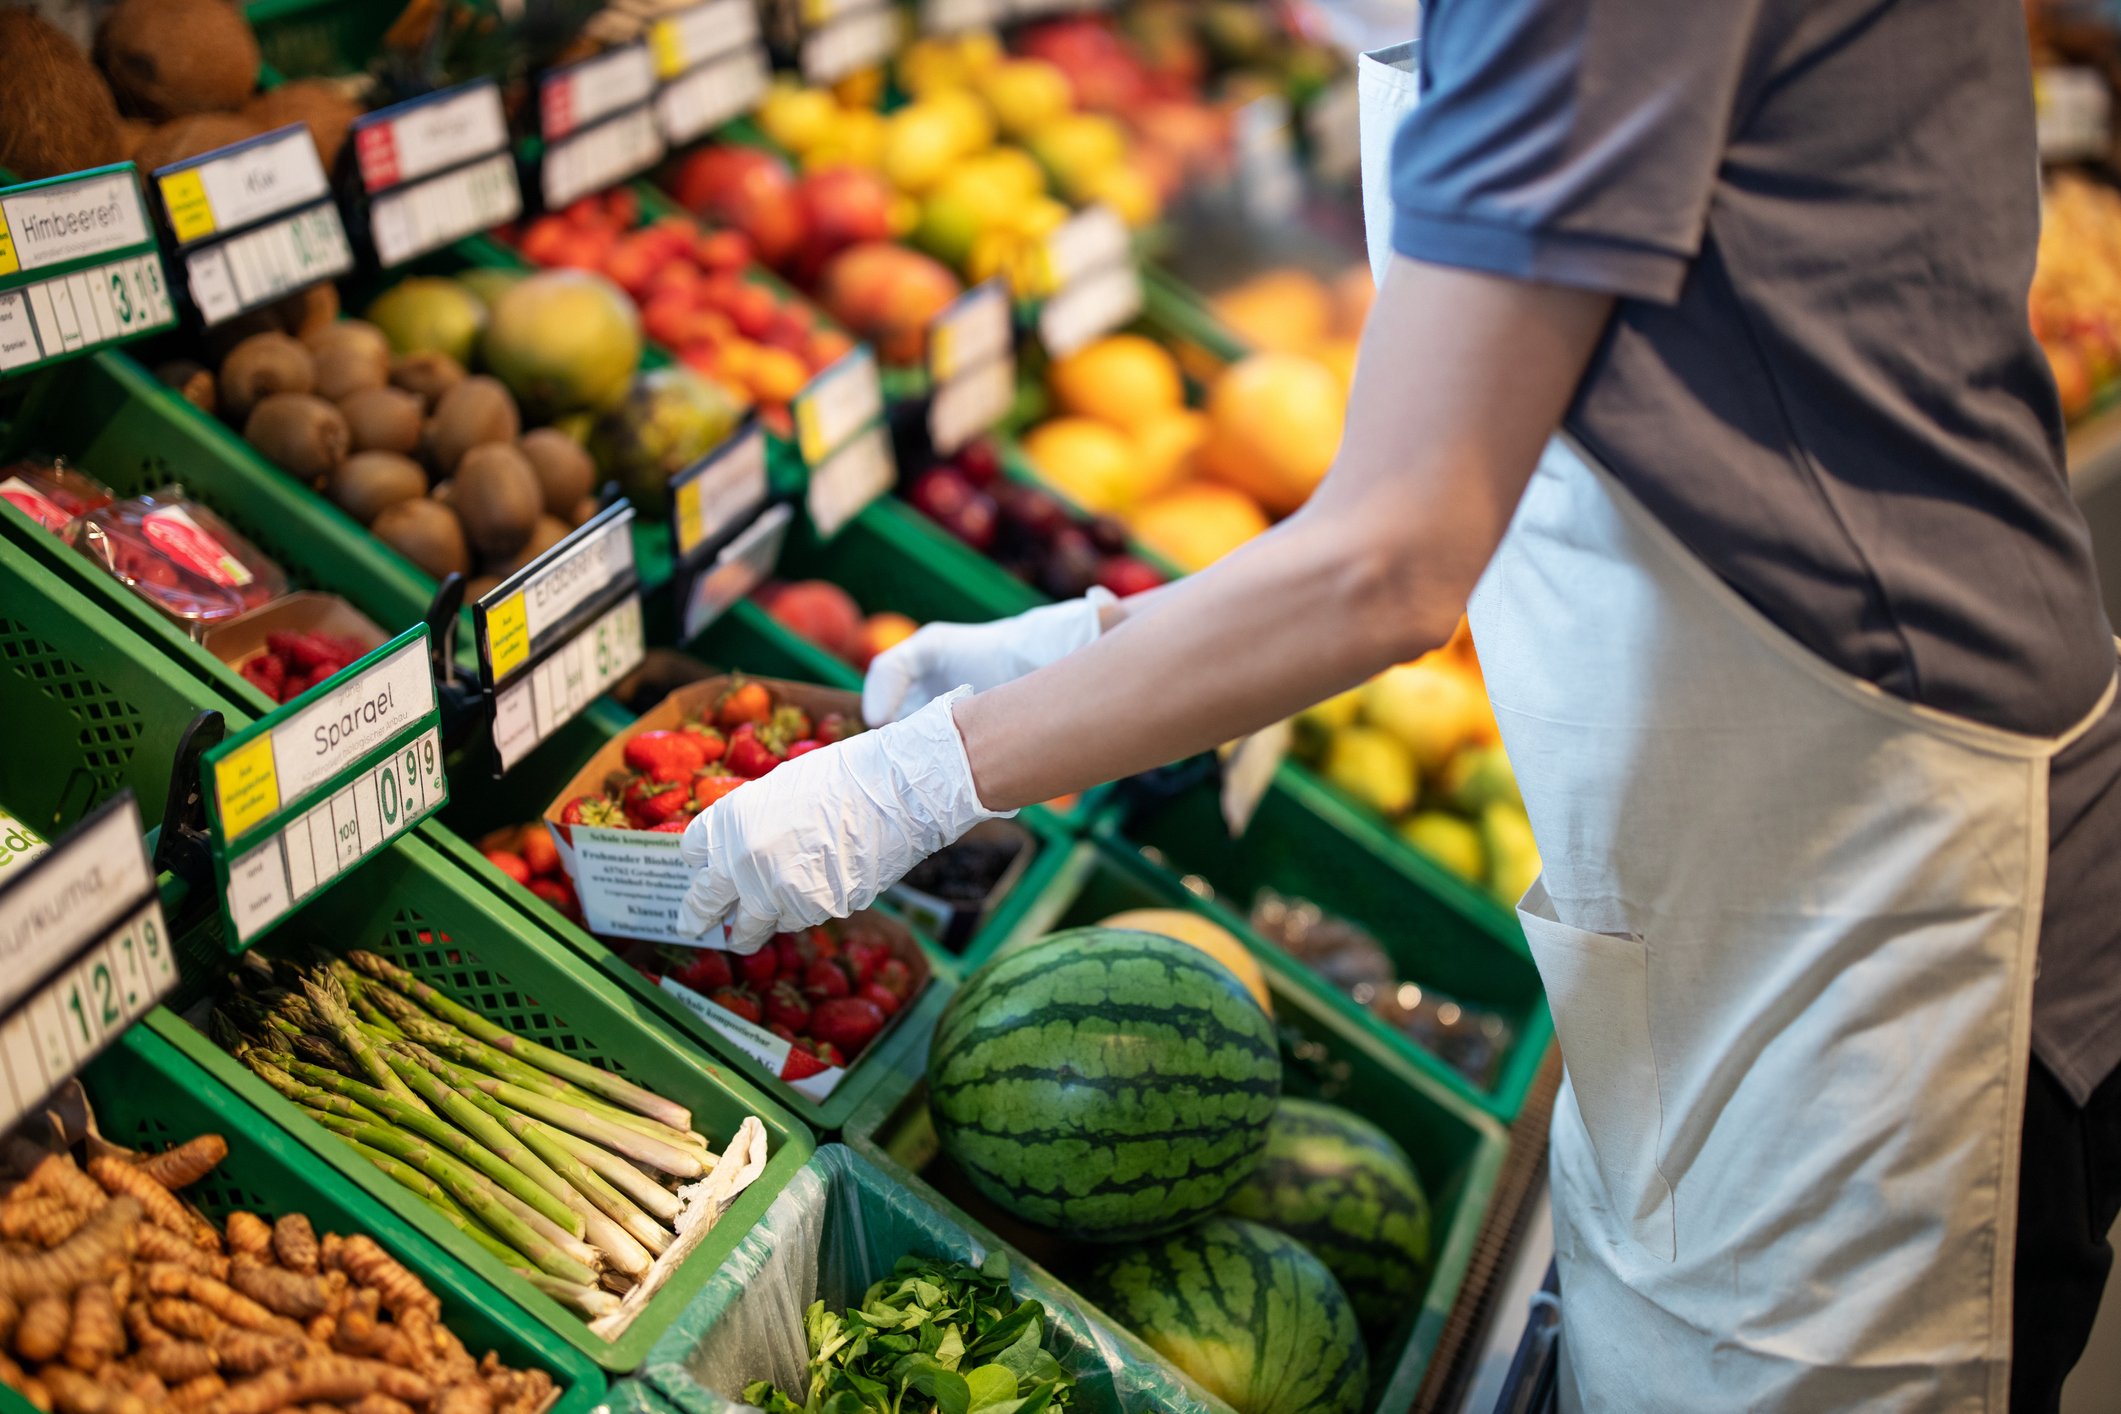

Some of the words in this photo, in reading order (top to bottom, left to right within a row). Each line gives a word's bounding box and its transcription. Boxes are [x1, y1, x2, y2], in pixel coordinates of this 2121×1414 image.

[21, 201, 125, 244] Himbeeren
[314, 682, 394, 756] Spargel
[338, 819, 356, 842] 100
[627, 905, 664, 919] Klasse
